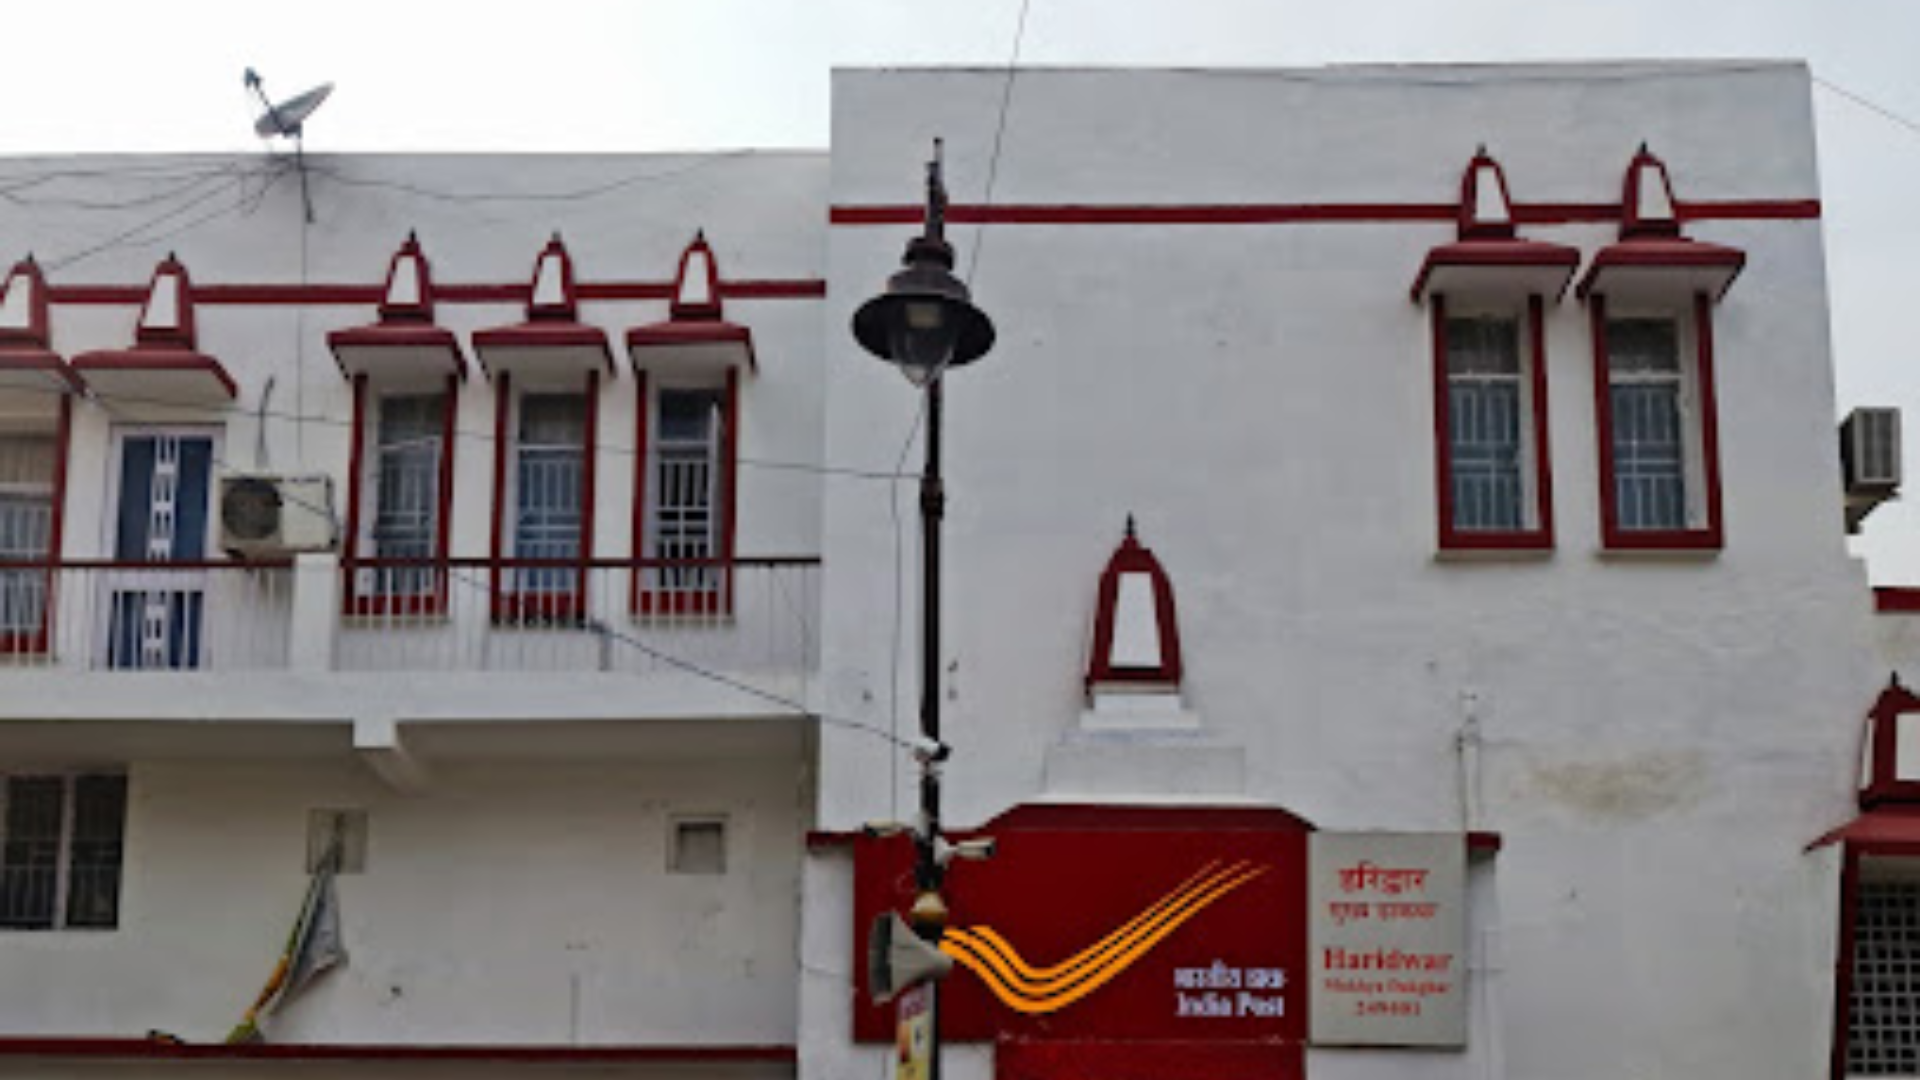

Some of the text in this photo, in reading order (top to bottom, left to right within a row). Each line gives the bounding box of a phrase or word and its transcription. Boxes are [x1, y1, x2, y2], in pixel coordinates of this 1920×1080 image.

[1337, 861, 1429, 894] हरिद्वार
[1324, 948, 1453, 970] Haridwar
[1175, 992, 1284, 1017] India Post
